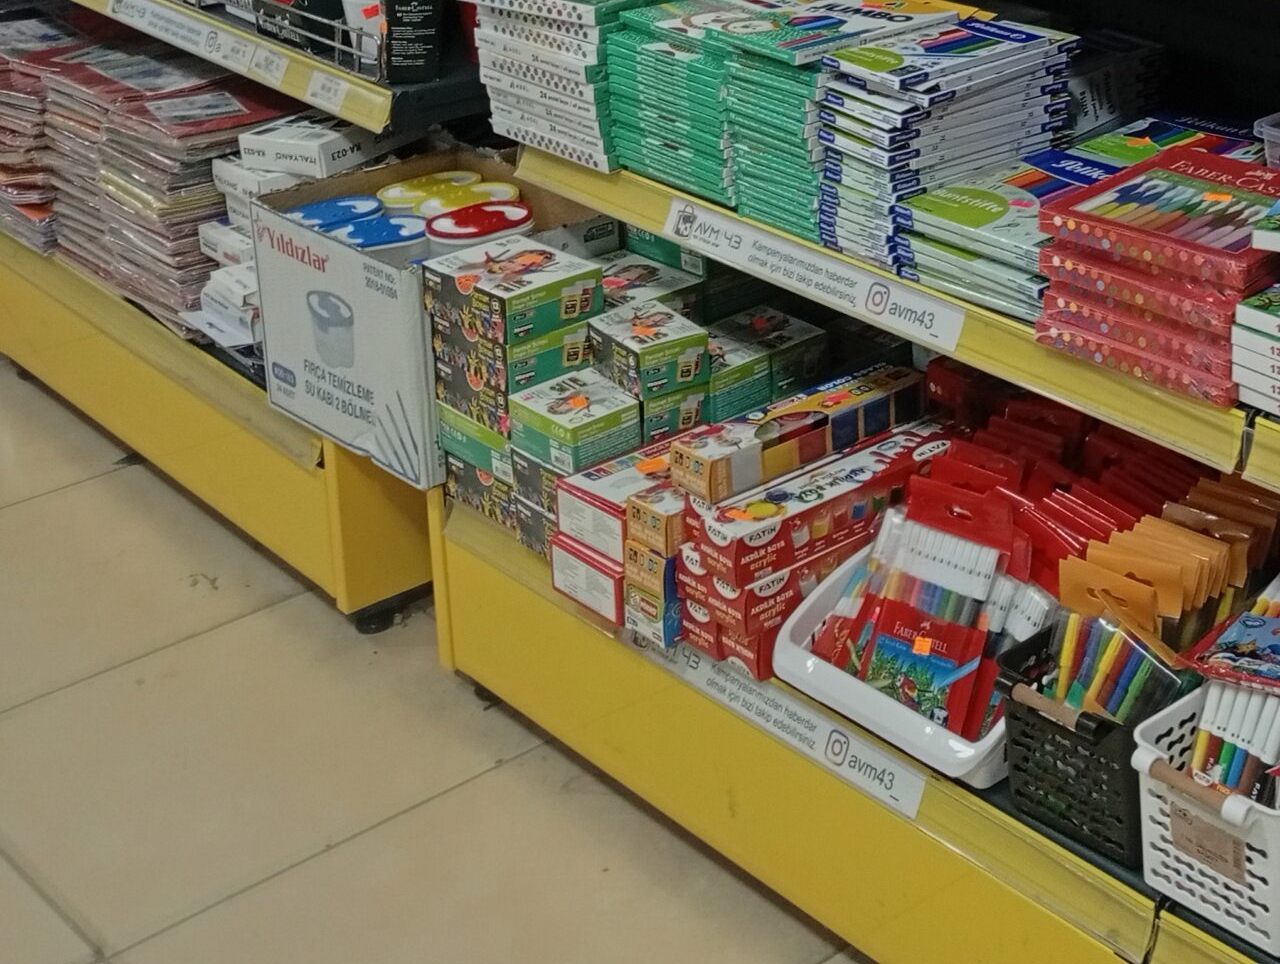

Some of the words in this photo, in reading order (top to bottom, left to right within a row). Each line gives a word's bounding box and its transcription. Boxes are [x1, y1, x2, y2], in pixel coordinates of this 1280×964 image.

[822, 2, 914, 23] JUMBO
[931, 186, 1004, 216] Buntstifte
[268, 226, 328, 273] Yıldızlar
[694, 219, 720, 242] AVM
[723, 229, 743, 251] 43
[748, 253, 767, 269] olmak
[767, 261, 781, 278] için
[783, 265, 795, 279] bizi
[794, 271, 812, 290] takip
[752, 239, 822, 278] Kampanyalarımızdan
[823, 267, 858, 290] haberdar
[888, 301, 939, 339] avm43_
[303, 358, 327, 383] FIRÇA
[304, 379, 315, 395] SU
[783, 705, 818, 734] haberdar
[847, 752, 900, 803] avm43_
